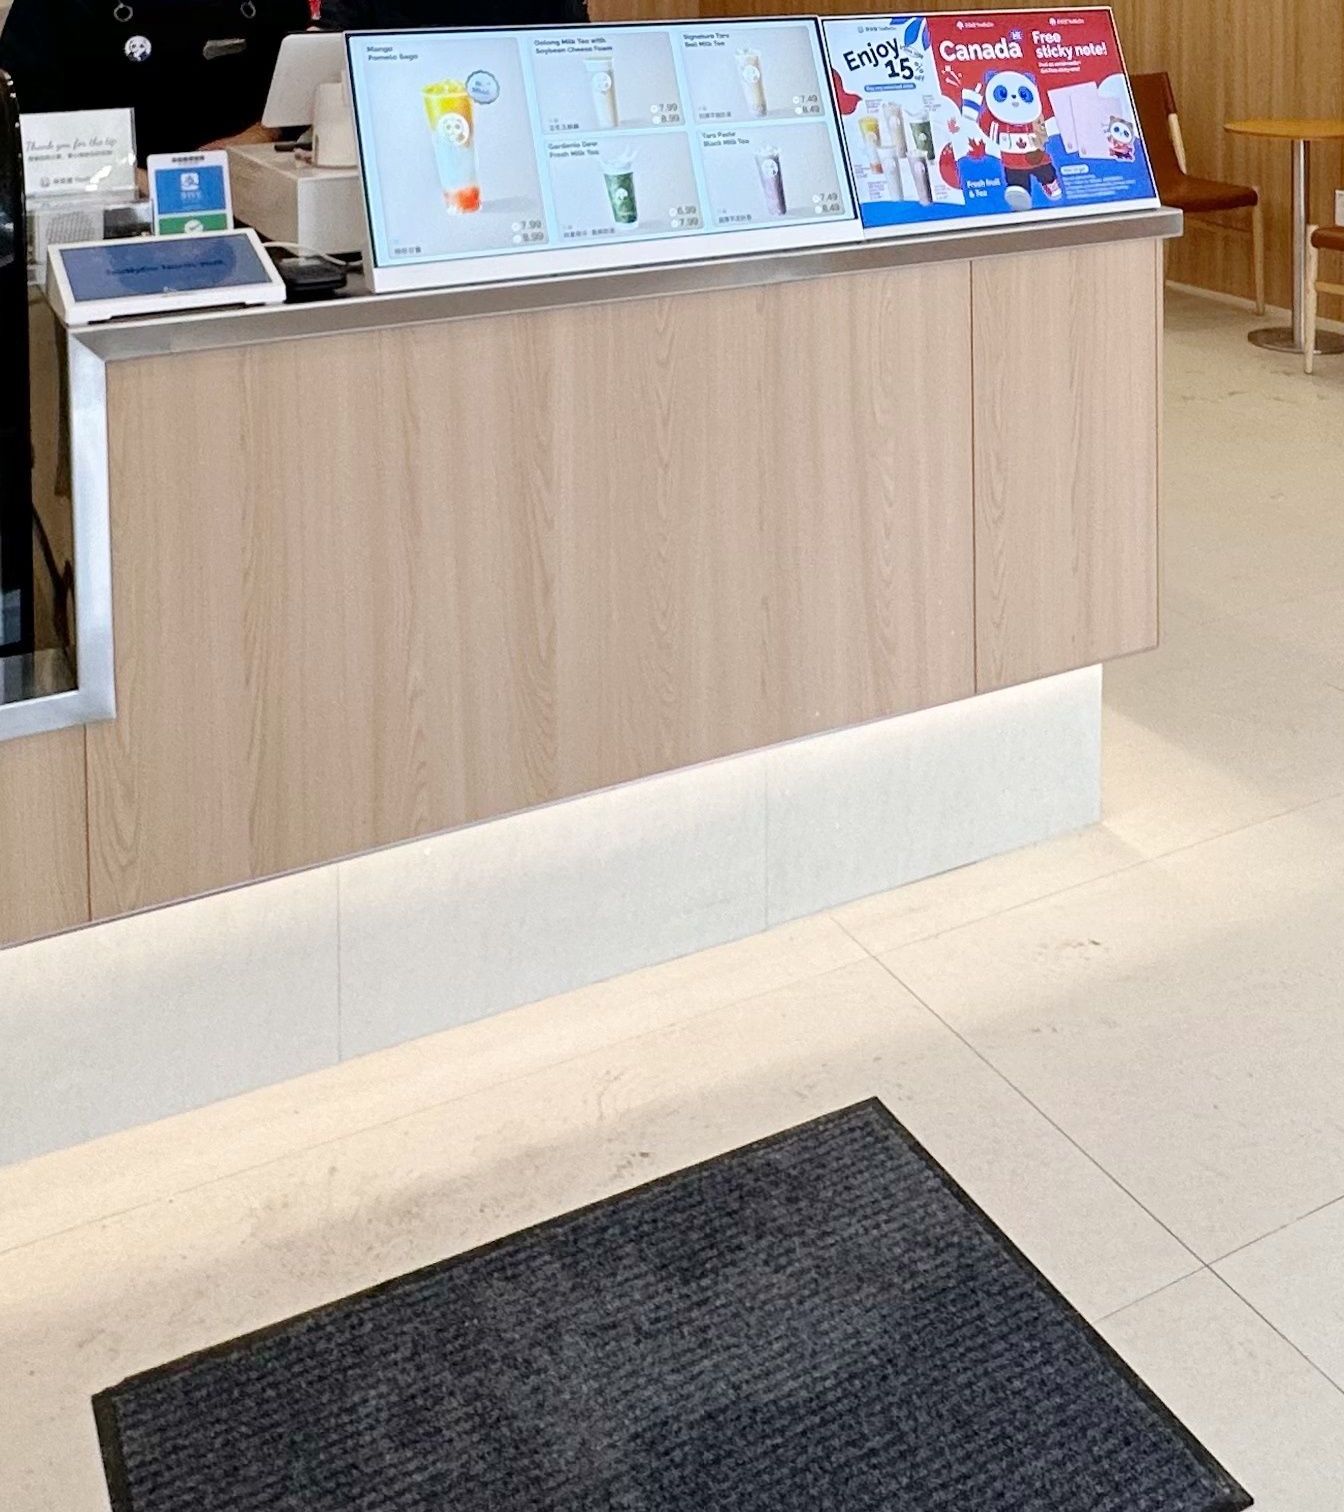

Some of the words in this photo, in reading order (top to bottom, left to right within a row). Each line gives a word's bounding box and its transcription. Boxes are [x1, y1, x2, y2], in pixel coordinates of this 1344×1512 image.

[1032, 31, 1061, 44] Free
[534, 39, 560, 47] Oolong
[535, 47, 565, 55] Soybean
[939, 37, 1024, 62] Canada
[1036, 44, 1073, 60] sticky
[1075, 41, 1108, 56] note!
[399, 53, 418, 61] Sago
[843, 38, 899, 71] Enjoy
[884, 57, 914, 80] 15
[801, 95, 817, 103] 7.49
[659, 103, 677, 112] 7.99
[26, 140, 54, 152] Thank
[56, 143, 70, 152] you
[72, 138, 86, 150] for
[89, 136, 103, 147] the
[820, 192, 838, 201] 7.49
[522, 220, 542, 229] 7.99
